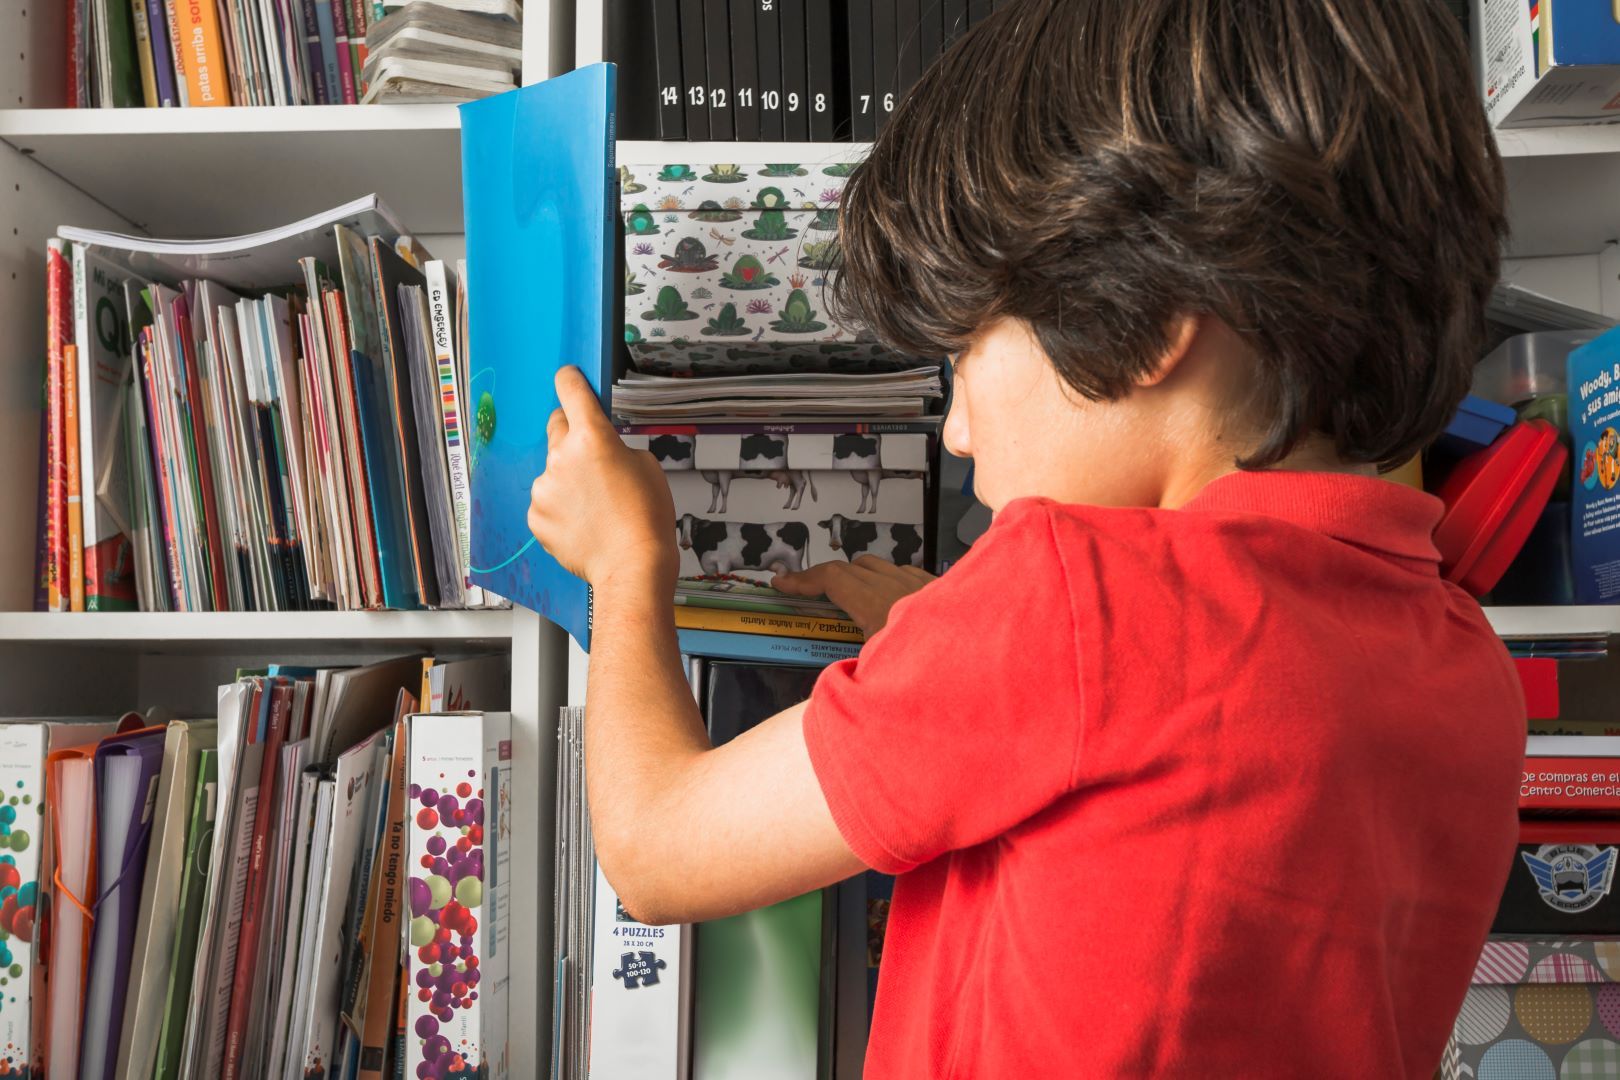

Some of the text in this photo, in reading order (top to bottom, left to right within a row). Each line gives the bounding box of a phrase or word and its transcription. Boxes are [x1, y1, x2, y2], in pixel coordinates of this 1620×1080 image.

[192, 27, 206, 64] arriba
[198, 66, 214, 102] patas
[661, 86, 678, 105] 14
[688, 86, 704, 105] 13
[710, 89, 726, 108] 12
[738, 88, 752, 107] 11
[761, 91, 779, 109] 10
[788, 92, 799, 111] 9
[815, 94, 825, 112] 8
[860, 95, 870, 113] 7
[883, 93, 894, 112] 6
[432, 290, 447, 348] ED EMBERLEY
[1580, 363, 1620, 400] Woody, B
[1582, 412, 1586, 424] y
[1588, 396, 1601, 416] sus
[450, 453, 461, 472] ¡Qué
[453, 471, 465, 491] fácil
[455, 491, 464, 500] es
[456, 502, 466, 531] dibujar
[741, 616, 765, 625] Martín
[768, 619, 792, 629] Muñoz
[795, 622, 810, 630] Juan
[819, 624, 864, 636] arrapata
[1539, 772, 1588, 783] compras
[1591, 773, 1605, 782] en
[1609, 772, 1620, 782] el
[1520, 785, 1562, 796] Centro
[1550, 846, 1583, 857] BLUE
[383, 821, 403, 923] Ya no tengo miedo
[1550, 895, 1594, 908] LEADER
[613, 927, 664, 938] 4 PUZZLES
